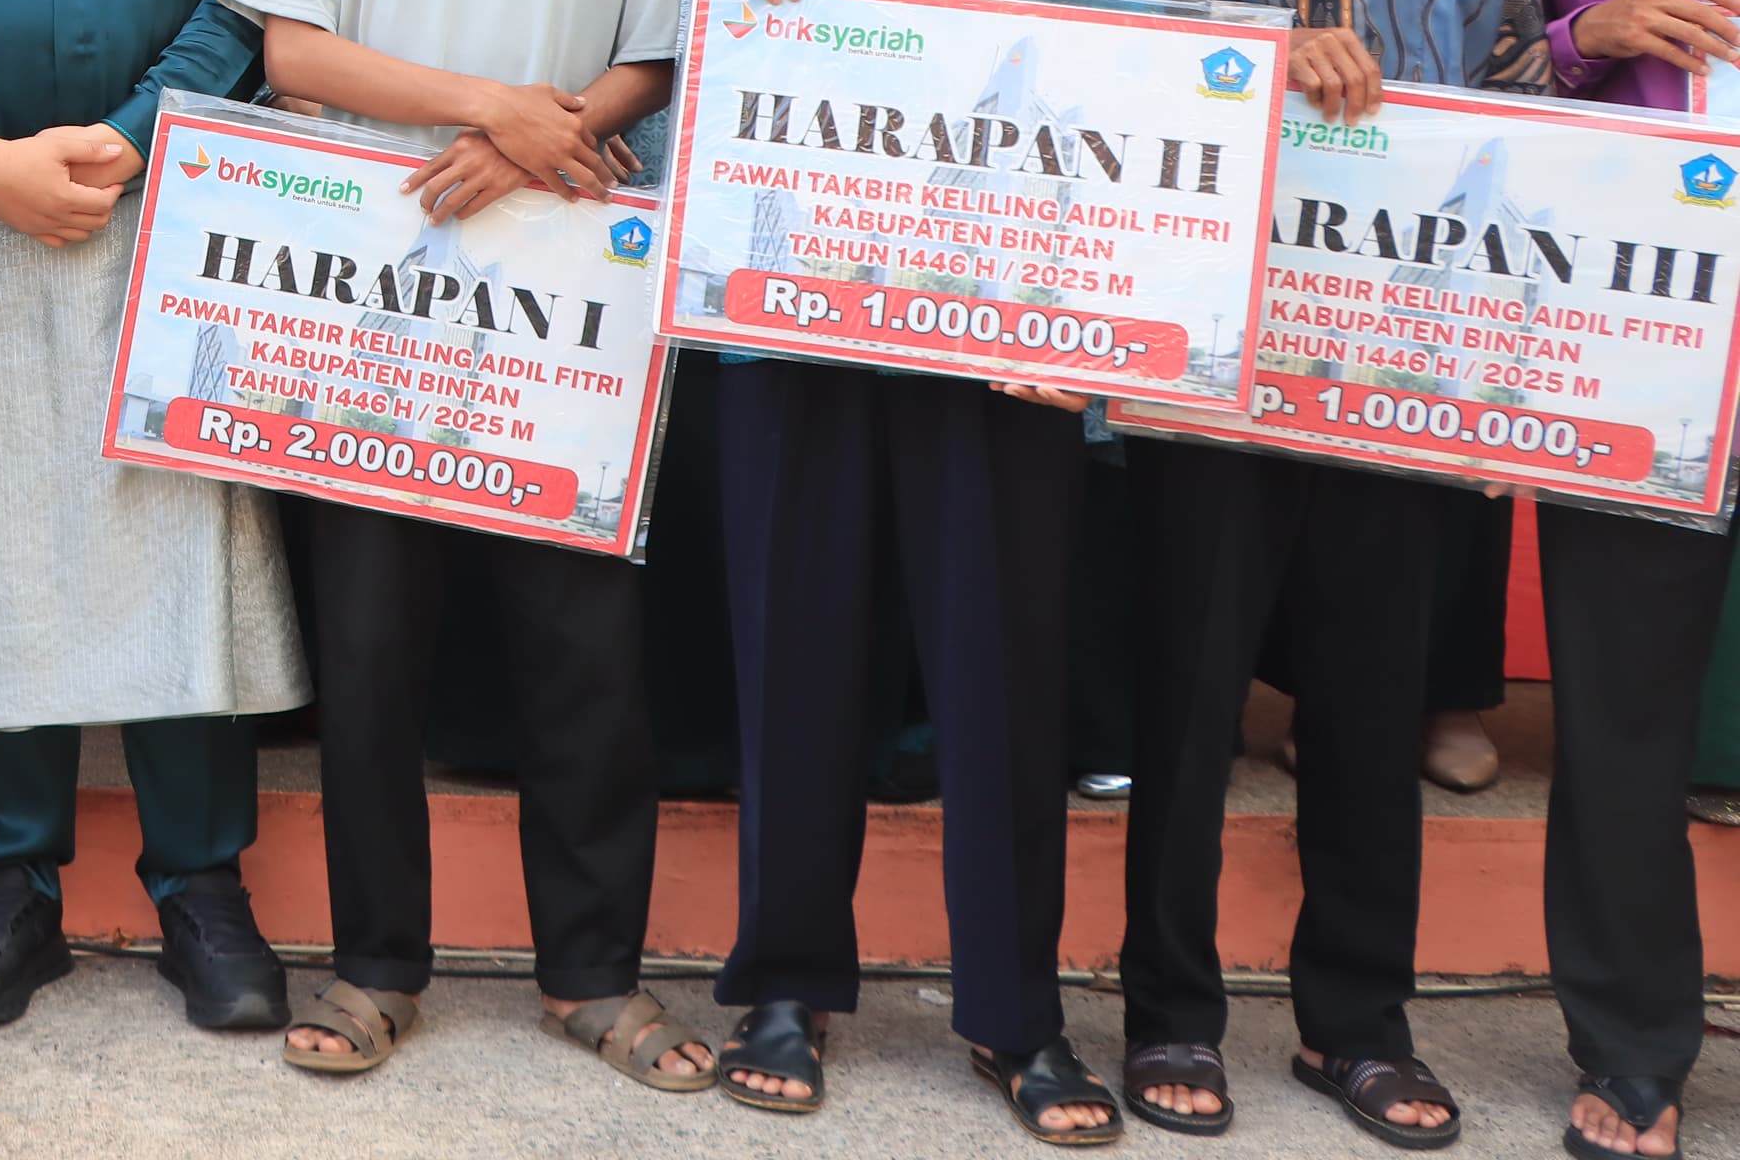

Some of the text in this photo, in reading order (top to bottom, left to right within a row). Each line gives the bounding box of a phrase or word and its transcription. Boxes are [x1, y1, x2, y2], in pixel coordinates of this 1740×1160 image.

[765, 13, 923, 55] brksyariah
[732, 89, 1227, 195] HARAPAN II
[218, 157, 362, 204] brksyariah
[292, 195, 316, 203] berkah
[318, 199, 336, 207] untuk
[712, 160, 1231, 243] PAWAI TAKBIR KELILING AIDIL FITRI
[789, 233, 889, 266] TAHUN
[897, 248, 966, 275] 1446
[974, 257, 995, 280] H
[1021, 262, 1100, 290] 2025
[1108, 274, 1133, 296] M
[813, 205, 1115, 262] KABUPATEN BINTAN
[197, 231, 610, 350] HARAPAN I
[1604, 239, 1725, 305] III
[762, 280, 1147, 367] Rp. 1.000.000,-
[1268, 266, 1704, 349] TAKBIR KELILING AIDIL FITRI
[1269, 300, 1581, 364] KABUPATEN BINTAN
[160, 294, 624, 397] PAWAI TAKBIR KELILING AIDIL FITRI
[251, 341, 520, 408] KABUPATEN BINTAN
[1255, 333, 1347, 364] AHUN
[1355, 342, 1426, 374] 1446
[1434, 354, 1457, 378] H
[1484, 362, 1564, 394] 2025
[1572, 375, 1600, 400] M
[227, 367, 318, 403] TAHUN
[324, 385, 388, 415] 1446
[393, 397, 414, 420] H
[435, 405, 505, 436] 2025
[511, 418, 535, 441] M
[1253, 385, 1611, 467] p. 1.000.000,-
[199, 407, 541, 507] Rp. 2.000.000,-
